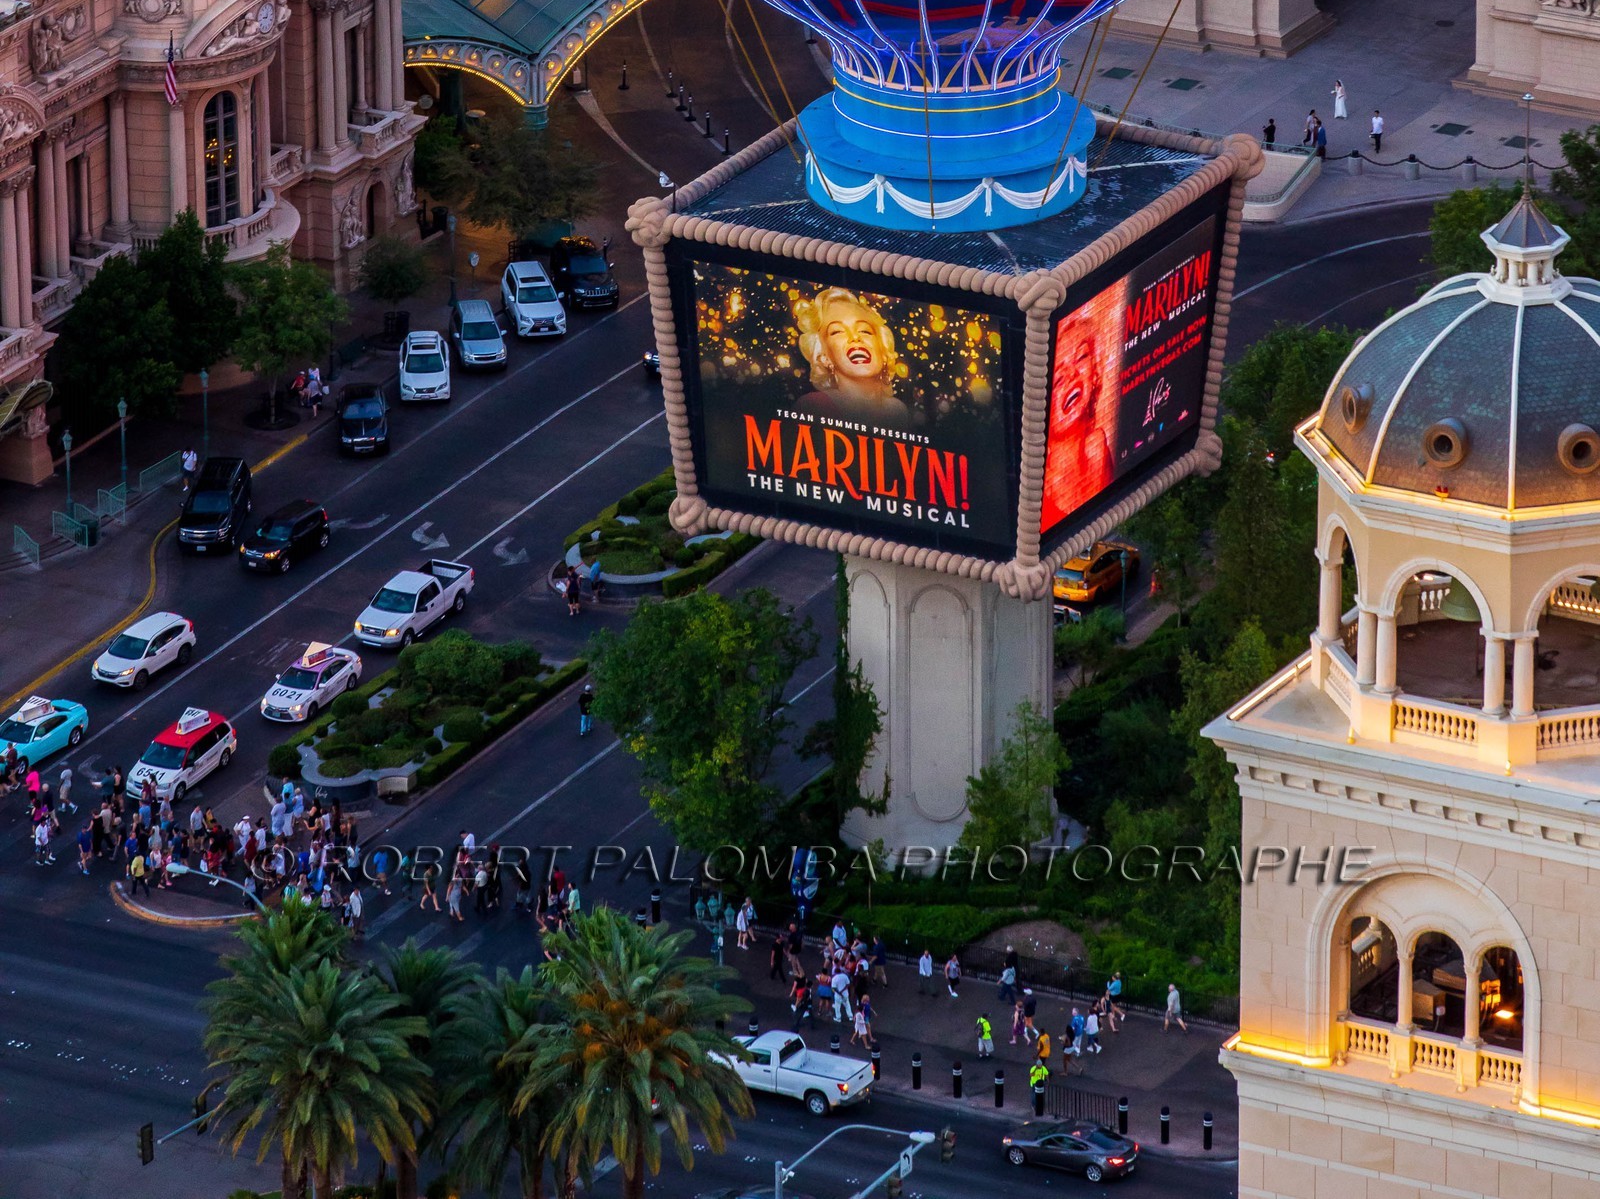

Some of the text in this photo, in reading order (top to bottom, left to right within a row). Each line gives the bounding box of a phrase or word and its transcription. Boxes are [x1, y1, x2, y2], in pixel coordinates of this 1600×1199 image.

[1123, 250, 1211, 341] MARILYN!
[1124, 289, 1206, 352] THE NEW MUSICAL
[777, 409, 931, 444] TEGAN SUMMER PRESENTS
[743, 414, 970, 511] MARILYN!
[747, 473, 970, 529] THE NEW MUSICAL
[271, 688, 303, 701] 6021
